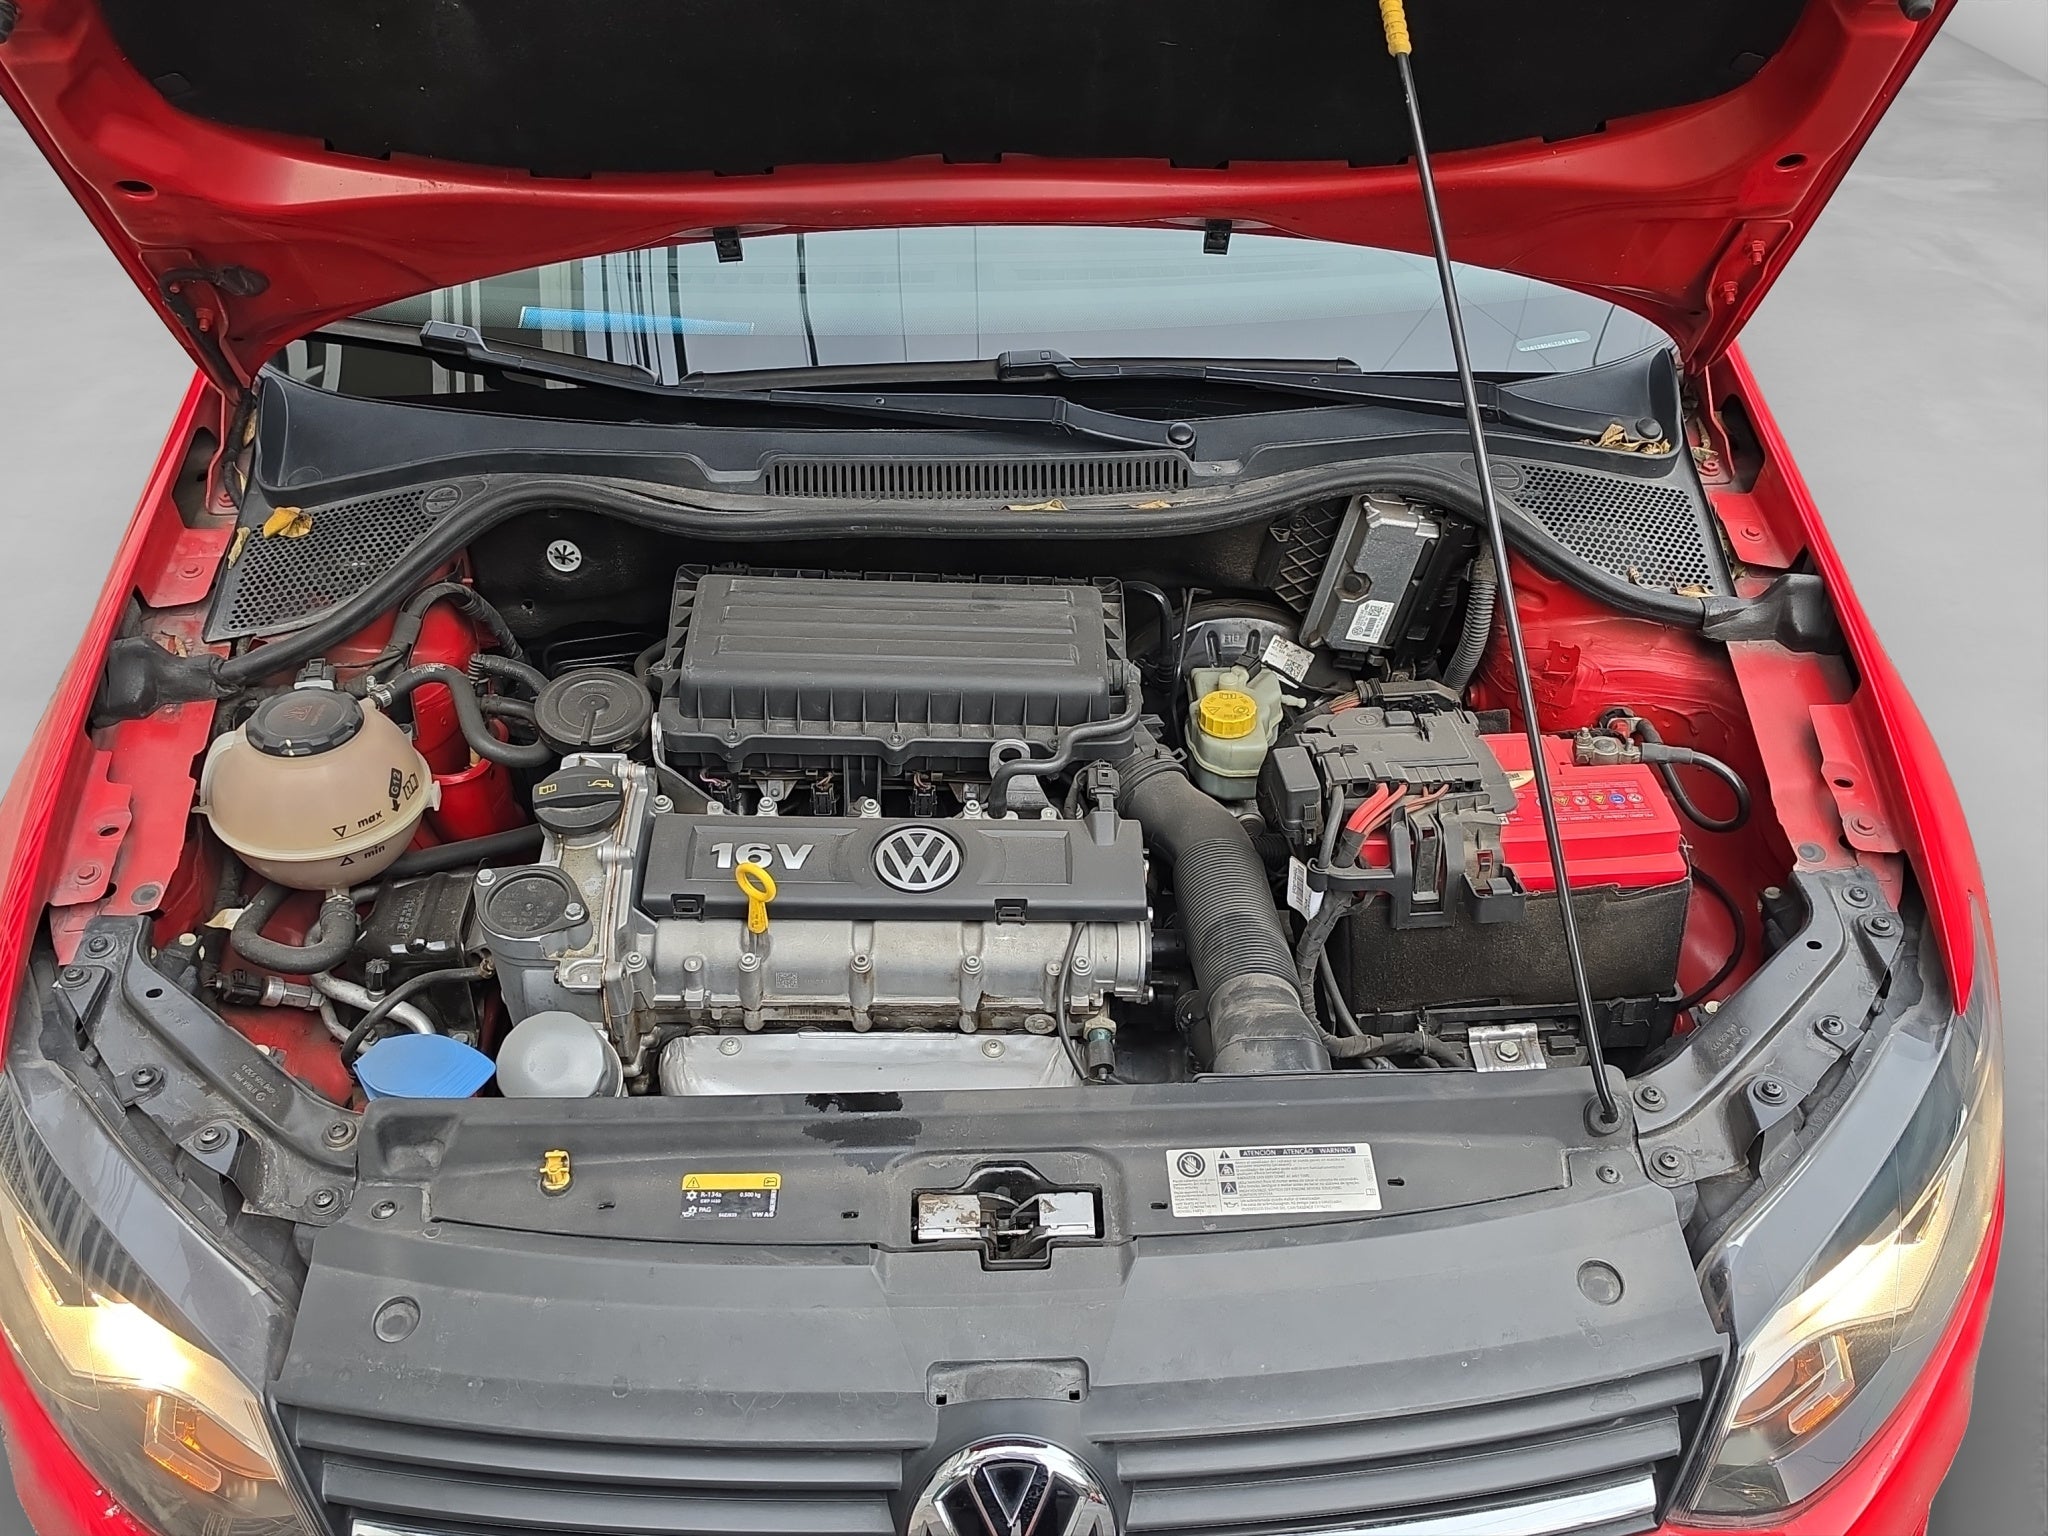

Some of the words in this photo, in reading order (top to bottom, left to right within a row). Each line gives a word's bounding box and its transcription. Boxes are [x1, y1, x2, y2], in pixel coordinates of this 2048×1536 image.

[390, 771, 402, 795] G12
[358, 810, 383, 828] max
[364, 844, 386, 859] min
[711, 842, 815, 870] 16V
[1318, 1146, 1352, 1154] WARNING
